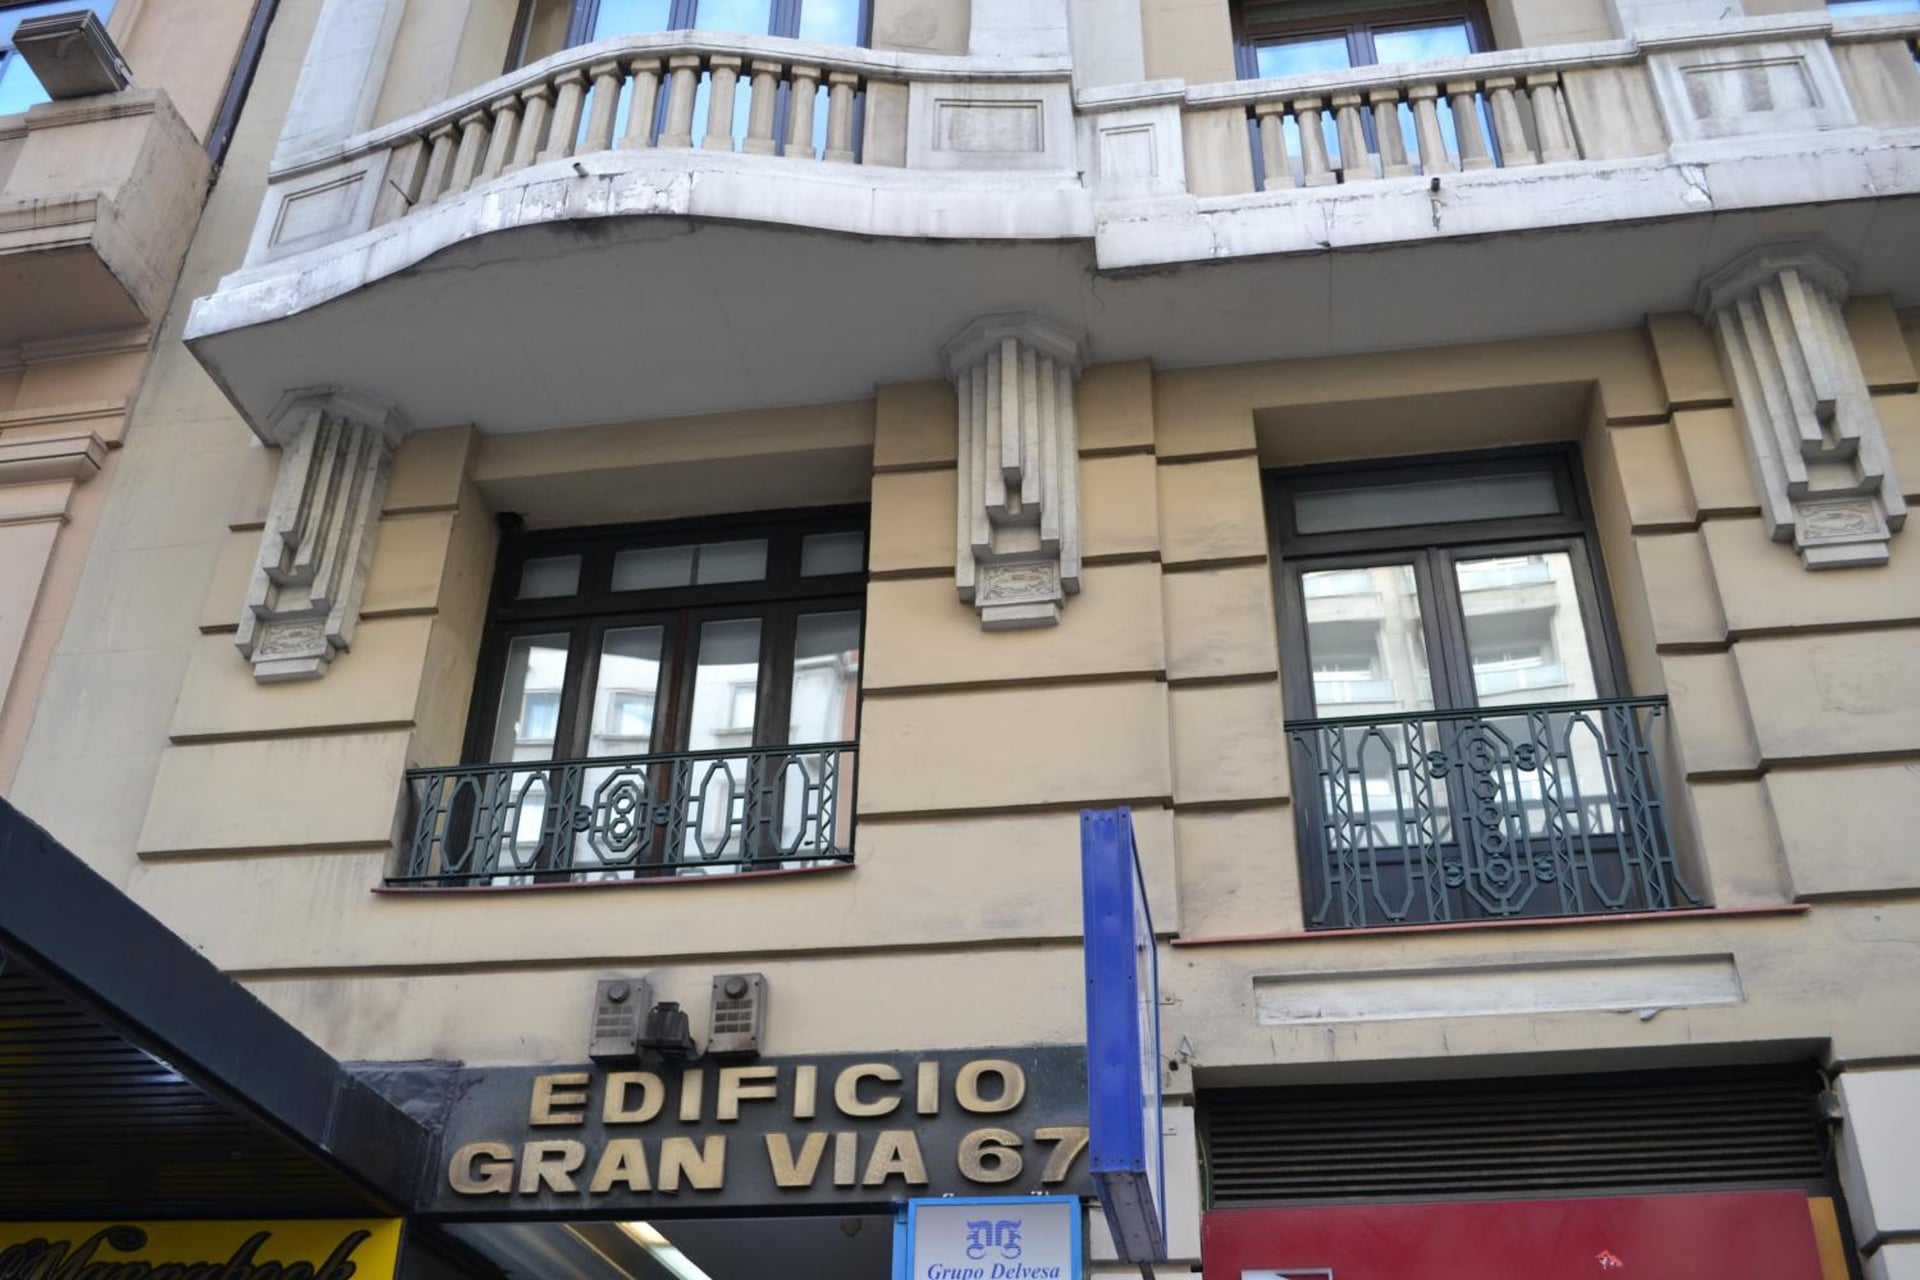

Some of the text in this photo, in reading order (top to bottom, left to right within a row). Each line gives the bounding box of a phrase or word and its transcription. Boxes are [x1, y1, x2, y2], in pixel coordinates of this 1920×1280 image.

[530, 1060, 1026, 1125] EDIFICIO
[448, 1126, 1090, 1194] GRAN VIA 67
[927, 1262, 1060, 1280] Grupo Delvesa
